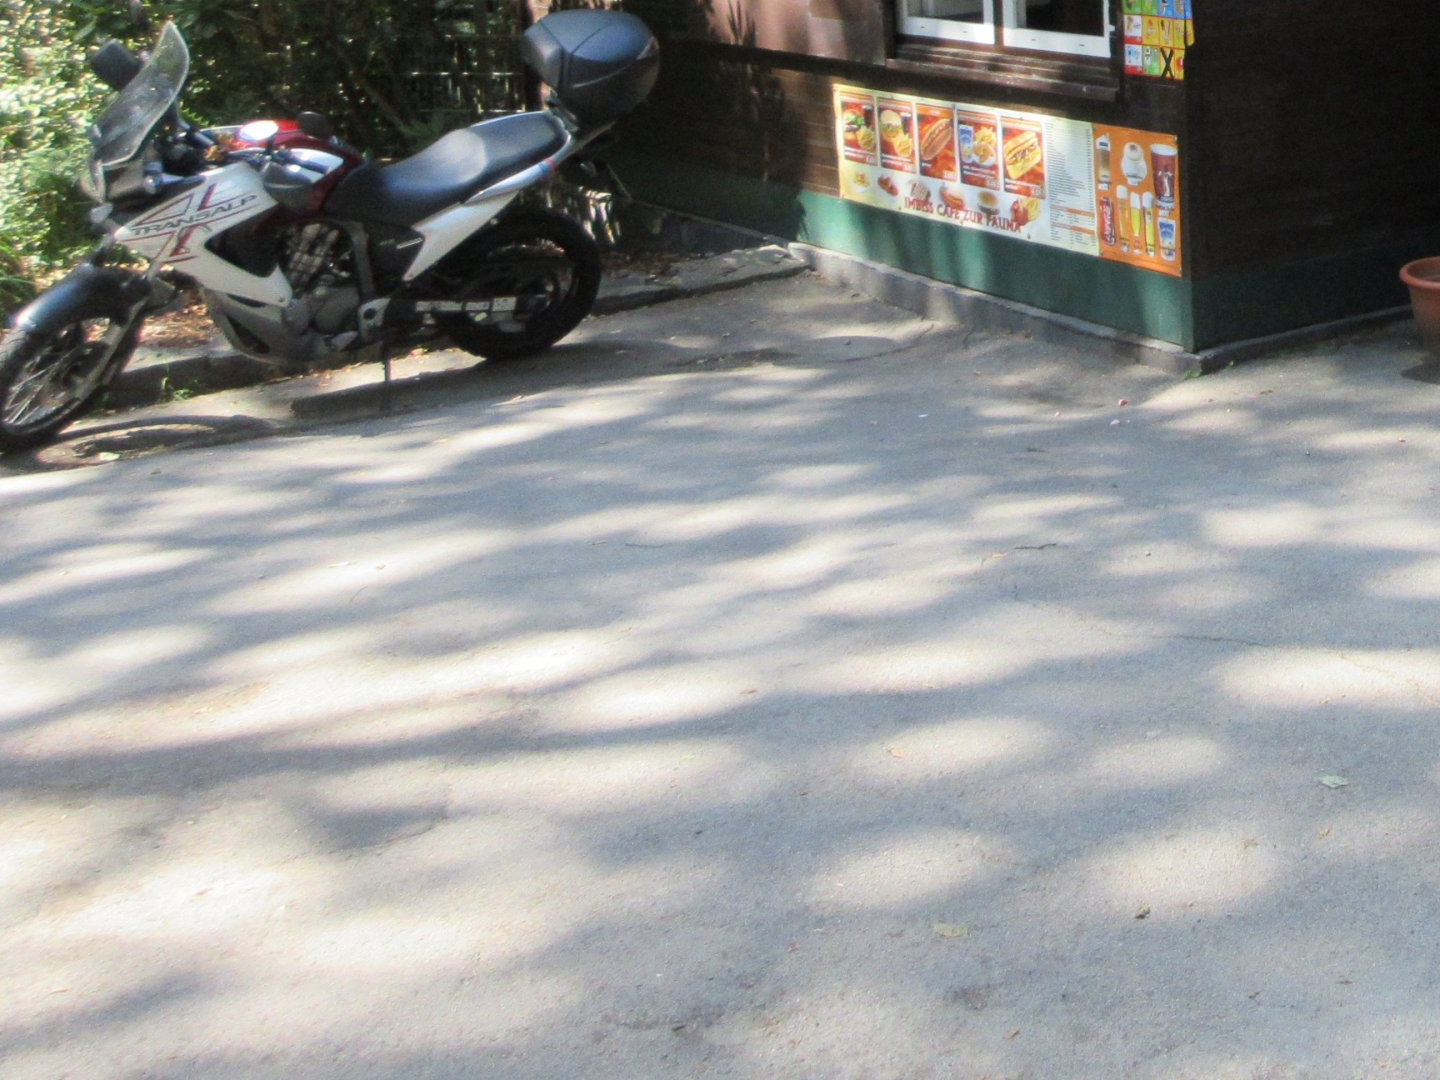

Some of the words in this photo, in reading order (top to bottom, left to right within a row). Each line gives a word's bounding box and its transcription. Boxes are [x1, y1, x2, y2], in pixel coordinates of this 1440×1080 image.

[131, 195, 257, 236] TRANSALP
[963, 210, 983, 224] ZUR
[986, 215, 1021, 233] FAUNA
